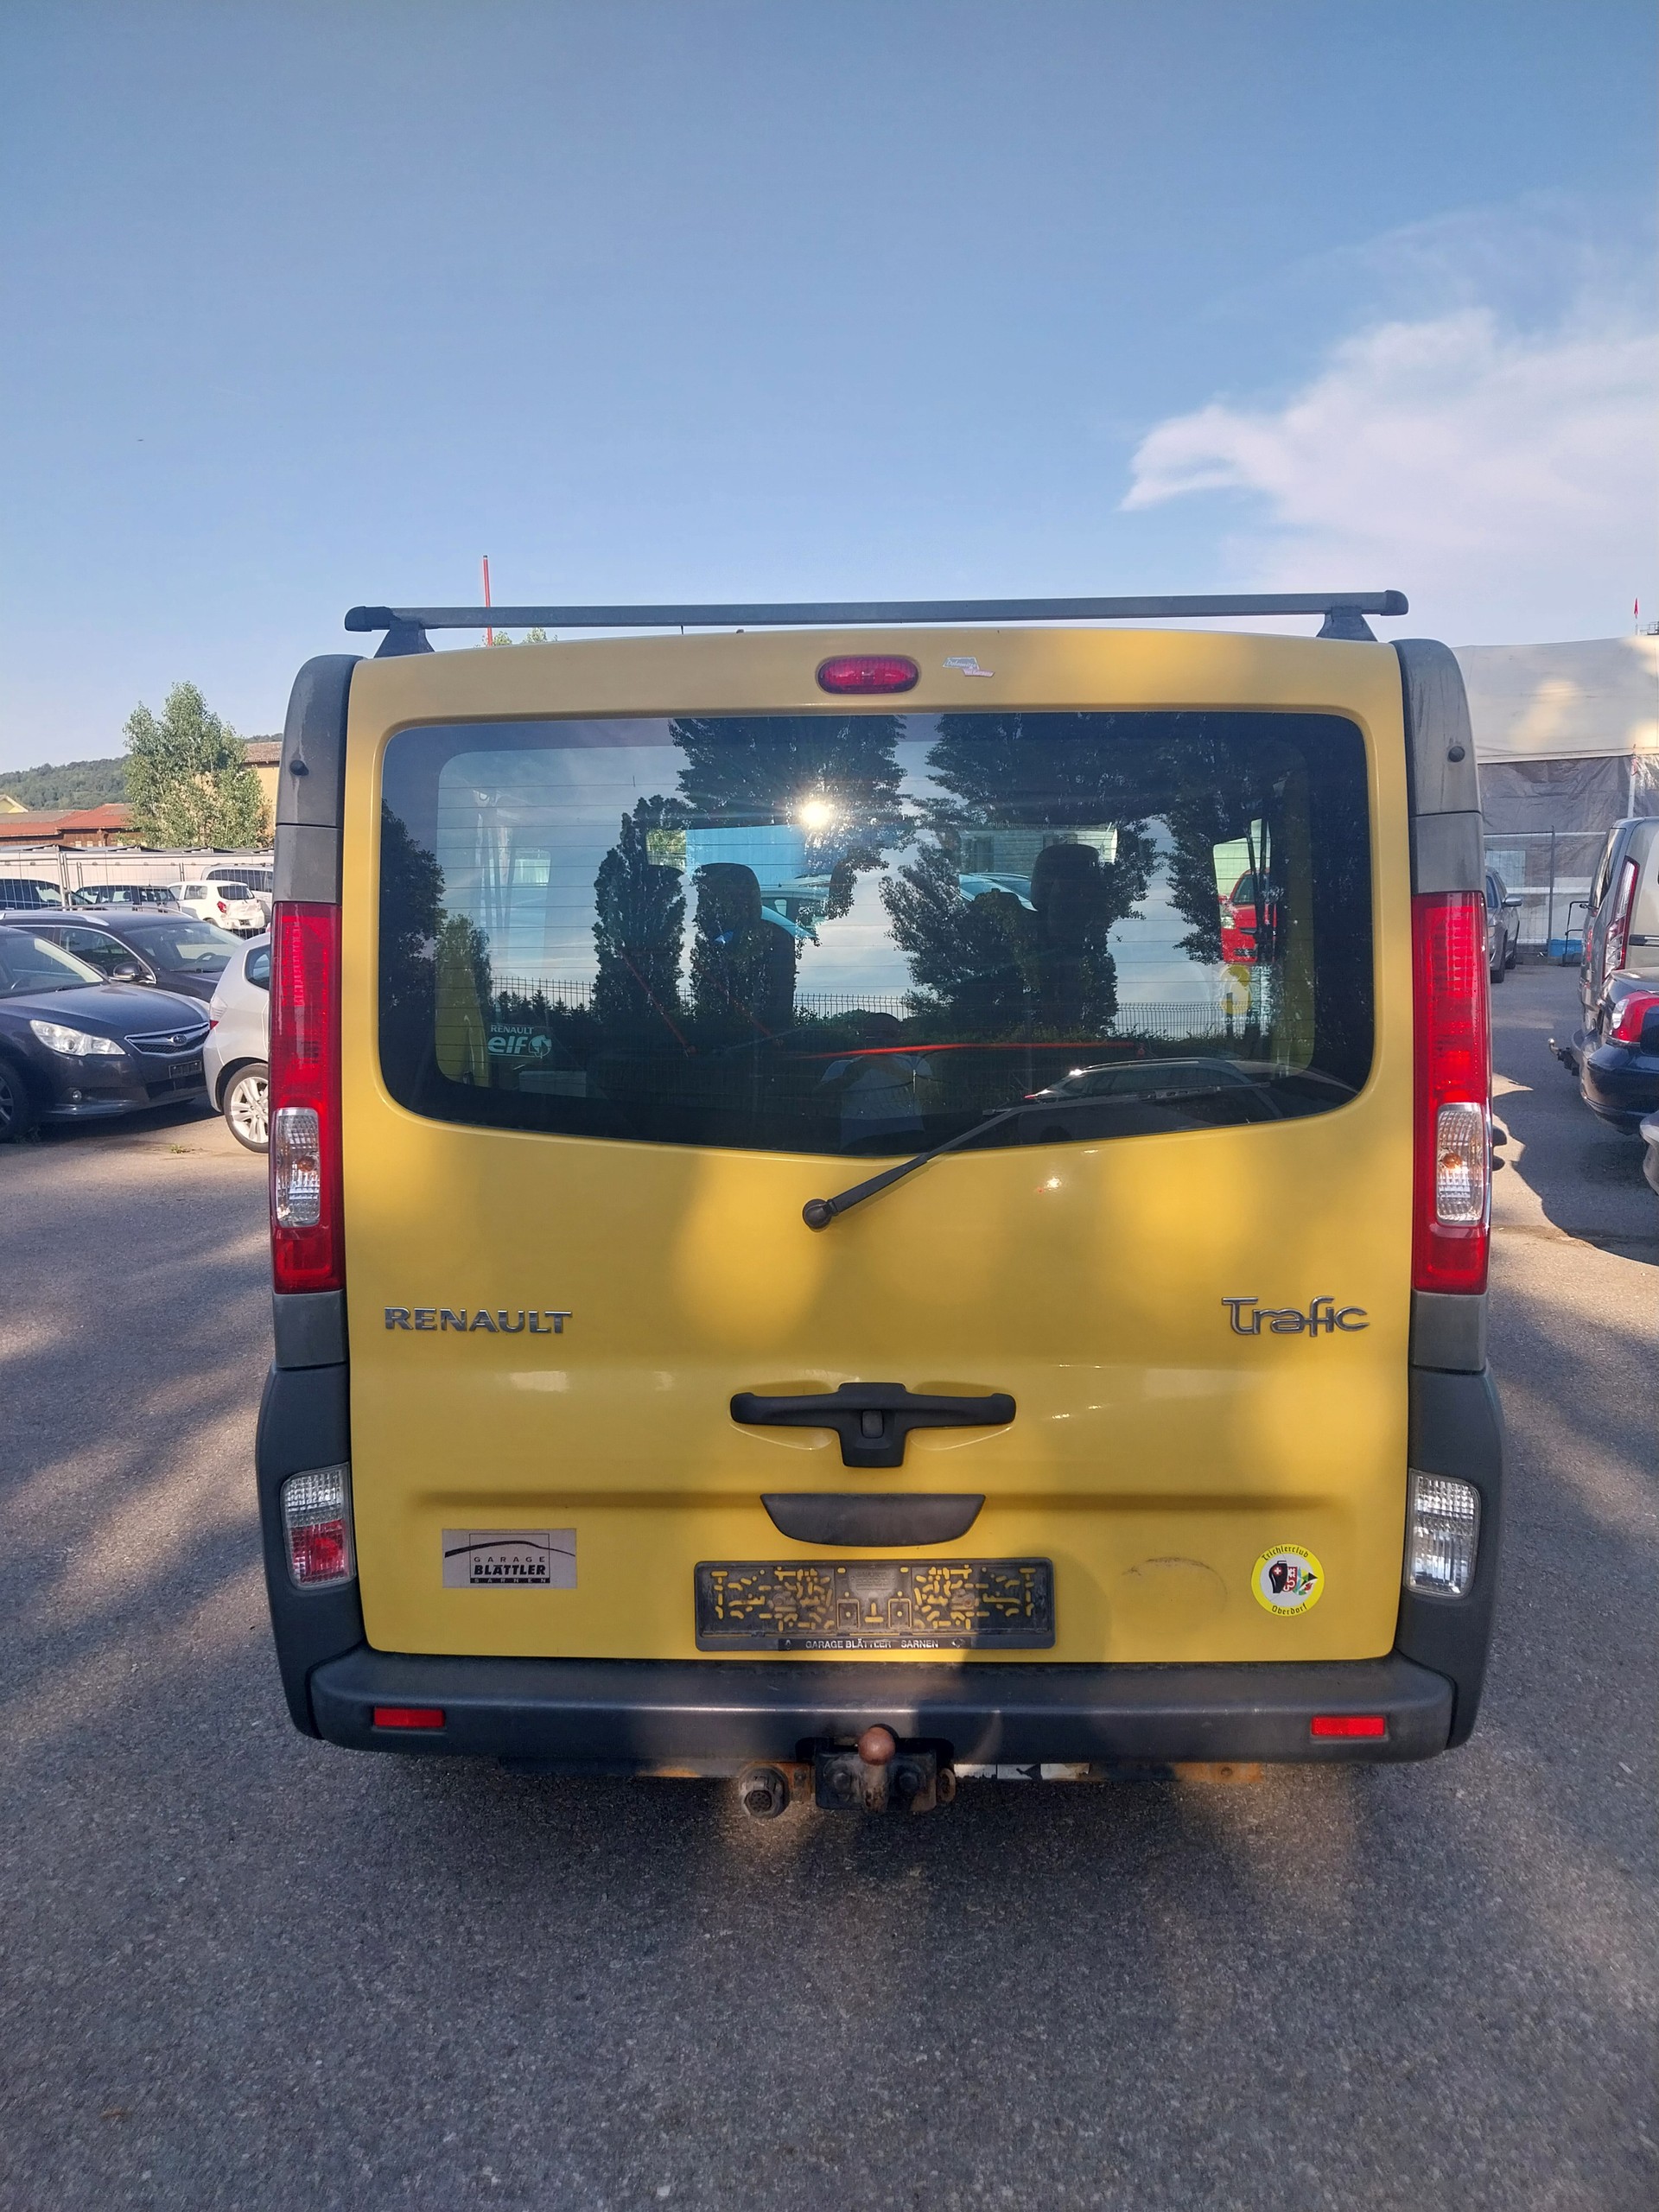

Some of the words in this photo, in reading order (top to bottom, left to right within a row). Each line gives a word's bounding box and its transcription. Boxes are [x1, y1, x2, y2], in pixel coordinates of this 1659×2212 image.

[490, 1024, 534, 1034] RENAULT
[487, 1036, 529, 1054] elf
[384, 1306, 572, 1333] RENAULT
[1222, 1296, 1370, 1337] Trafic
[1262, 1545, 1309, 1561] Trichlerclub
[474, 1564, 546, 1575] BLÄTTLER
[1271, 1602, 1307, 1616] Oberdorf
[805, 1640, 843, 1649] GARAGE
[900, 1639, 939, 1649] SARNEN
